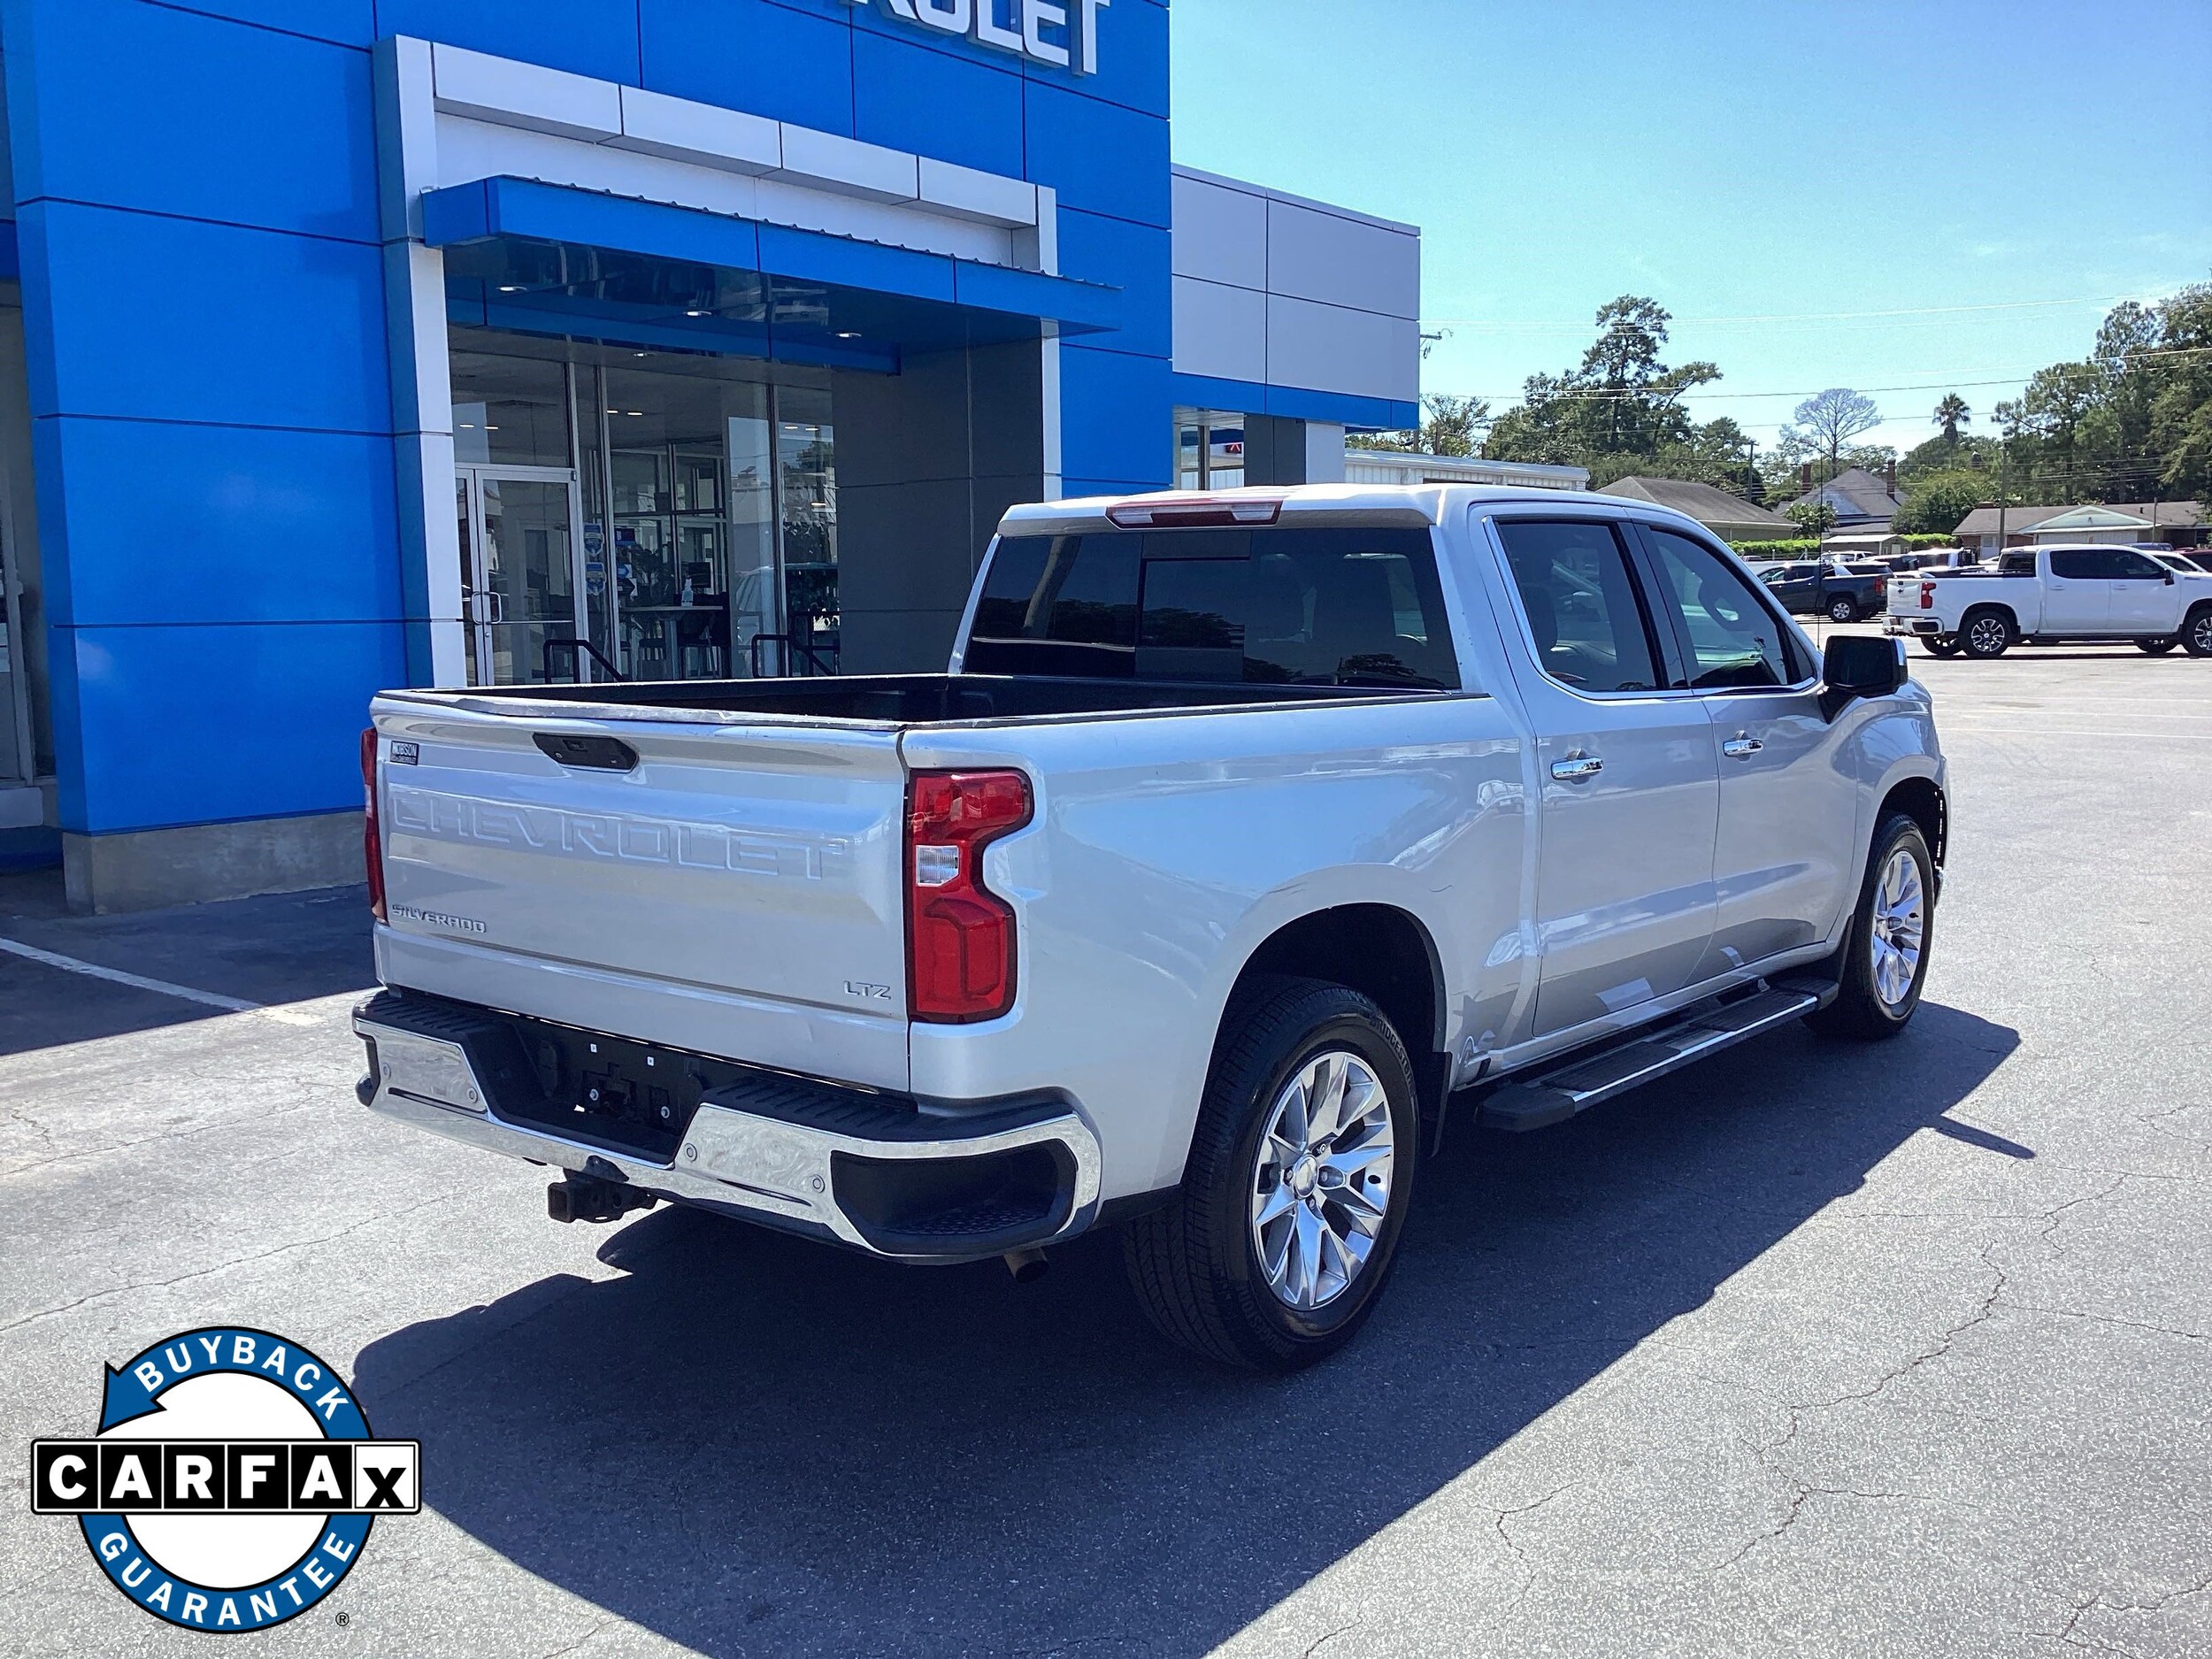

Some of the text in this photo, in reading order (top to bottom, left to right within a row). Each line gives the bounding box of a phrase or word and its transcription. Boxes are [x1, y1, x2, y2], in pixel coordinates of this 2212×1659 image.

[851, 0, 1110, 75] LET
[393, 796, 846, 881] CHEVROLET
[392, 903, 487, 933] SILVERADO
[843, 979, 892, 1001] LTZ
